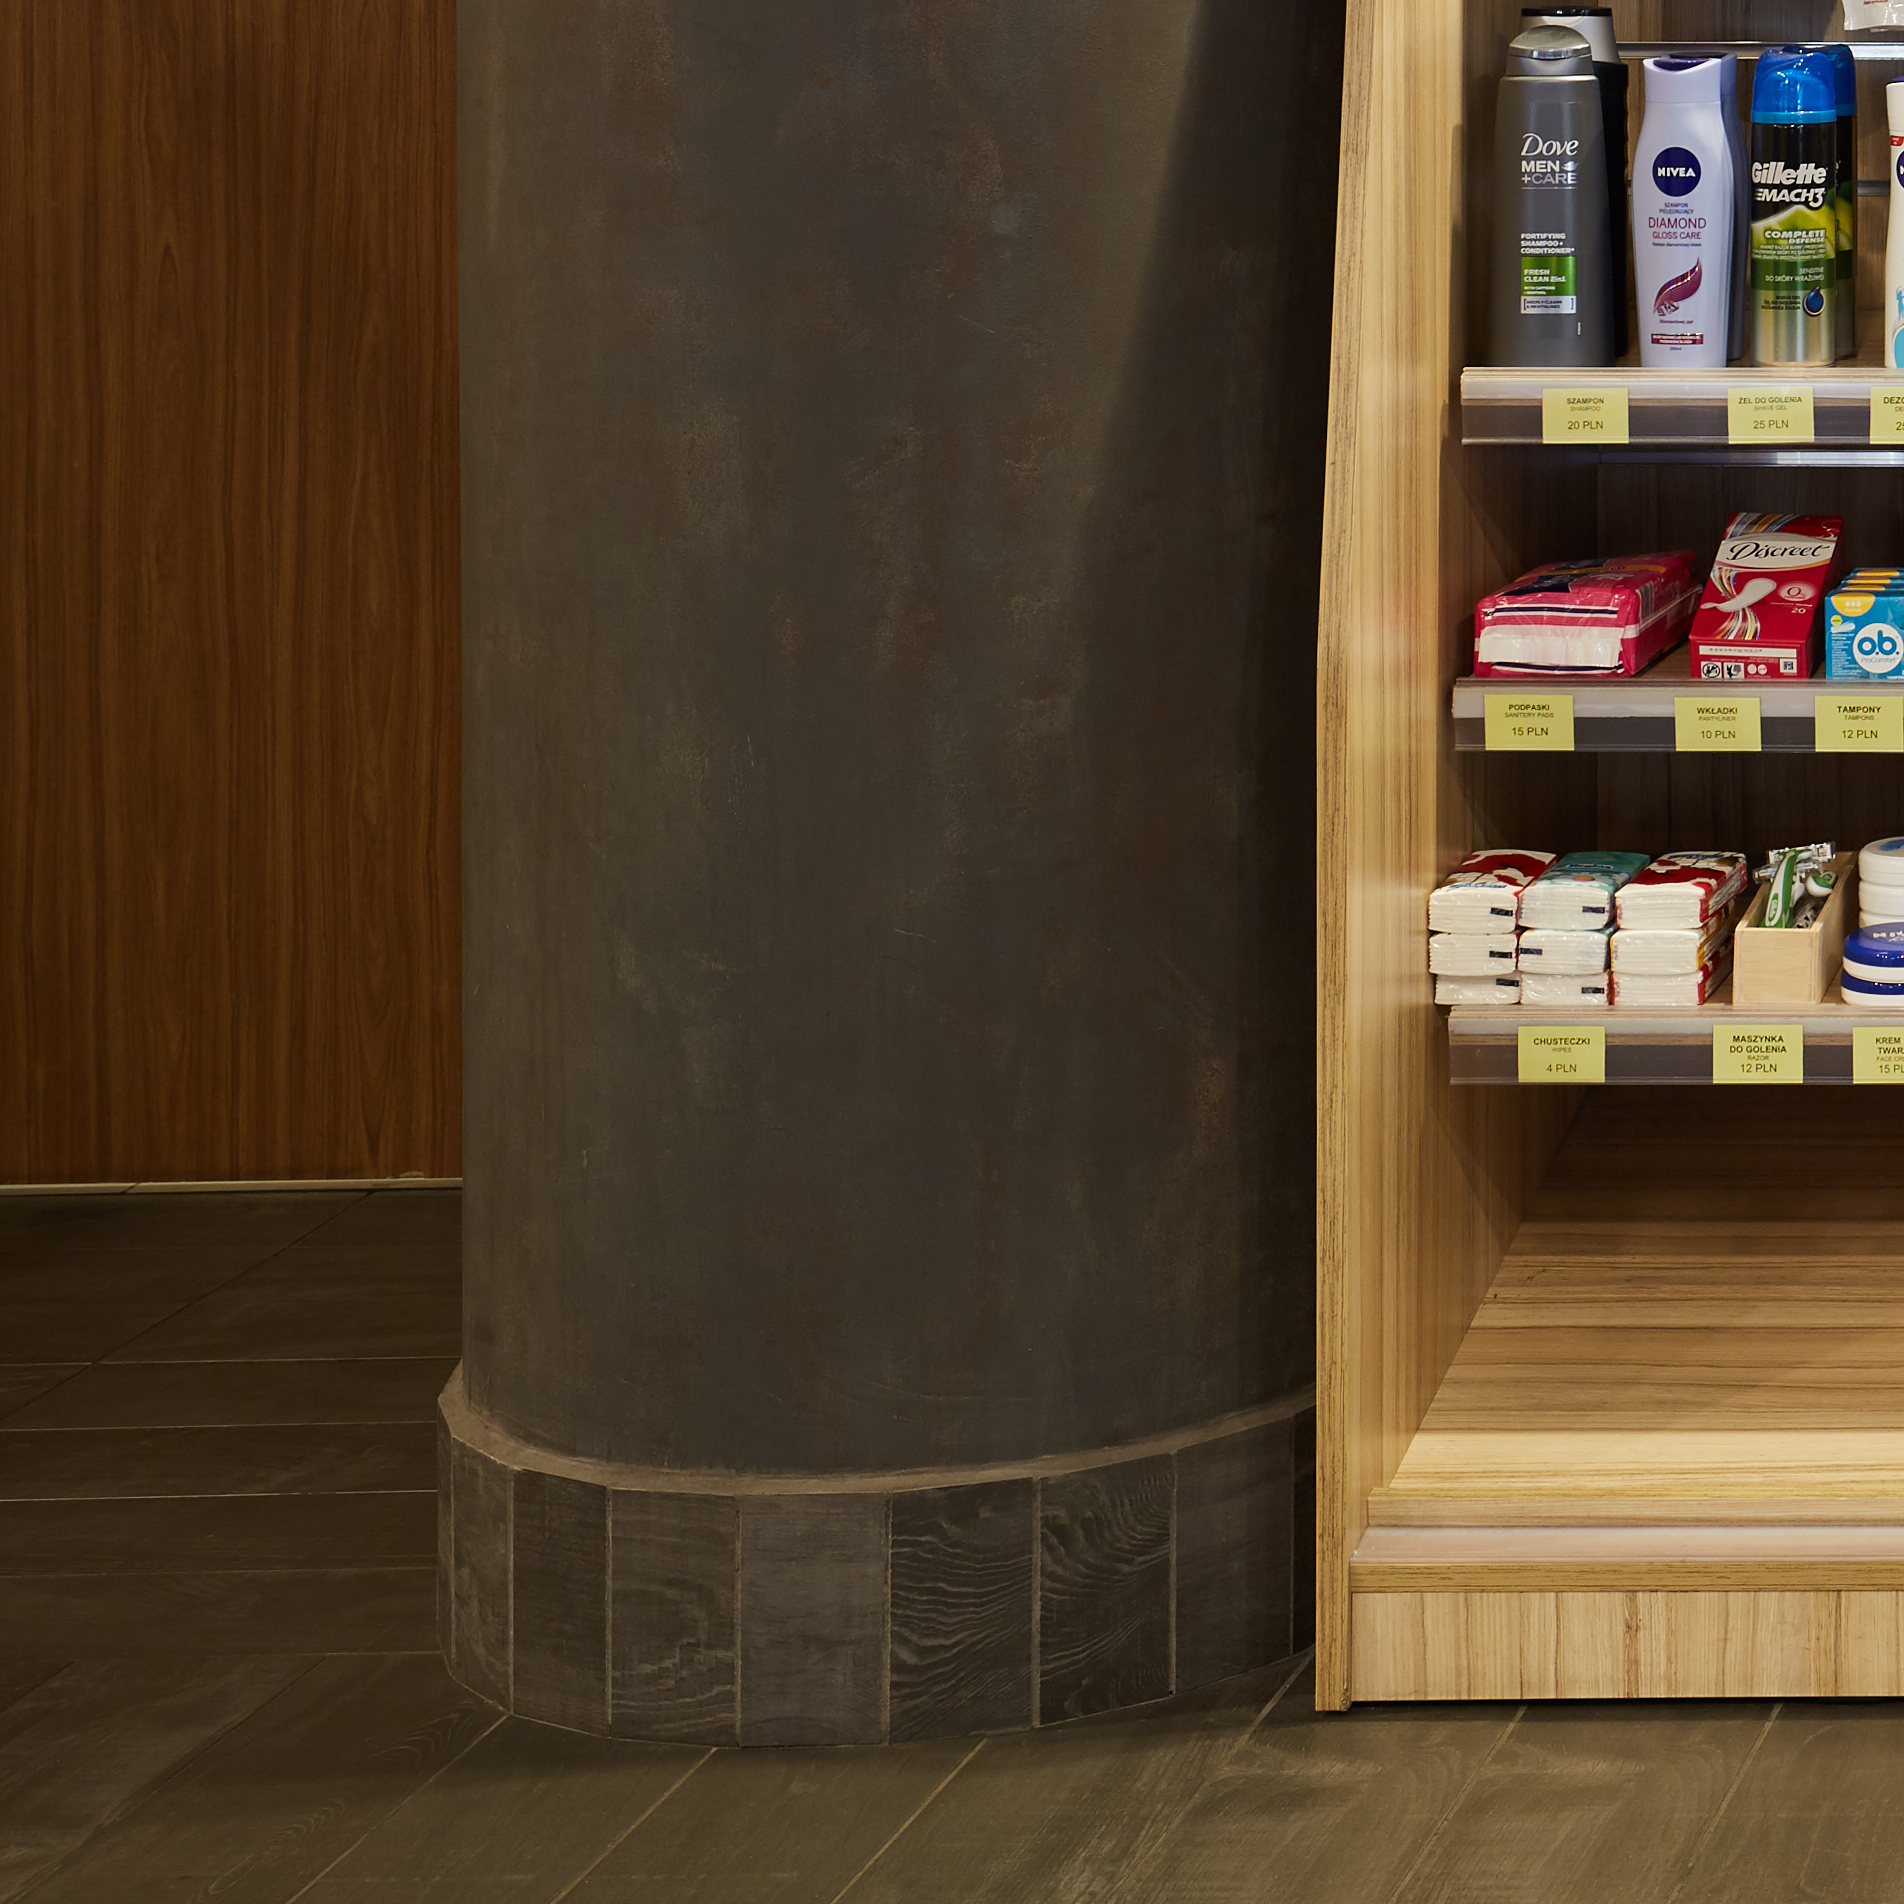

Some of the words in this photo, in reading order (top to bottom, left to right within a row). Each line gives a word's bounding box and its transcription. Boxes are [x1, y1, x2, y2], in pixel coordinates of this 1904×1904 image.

[1520, 132, 1580, 157] Dove
[1521, 160, 1560, 173] MEN
[1656, 166, 1696, 178] NIVEA
[1521, 172, 1578, 185] +CARE
[1751, 161, 1826, 185] Gillette
[1648, 217, 1707, 229] DIAMOND
[1652, 231, 1678, 240] GLOSS
[1679, 231, 1702, 240] CARE
[1763, 229, 1827, 239] COMPLETE
[1788, 237, 1826, 245] DEFENSE
[1566, 396, 1605, 405] SZAMPON
[1567, 419, 1581, 430] 20
[1583, 419, 1604, 430] PLN
[1725, 541, 1831, 561] Discreet
[1856, 629, 1900, 656] o.b.
[1836, 705, 1882, 714] TAMPONY
[1841, 729, 1854, 740] 12
[1856, 729, 1878, 740] PLN
[1533, 1037, 1591, 1046] CHUSTECZKI
[1546, 1063, 1553, 1074] 4
[1555, 1063, 1577, 1074] PLN
